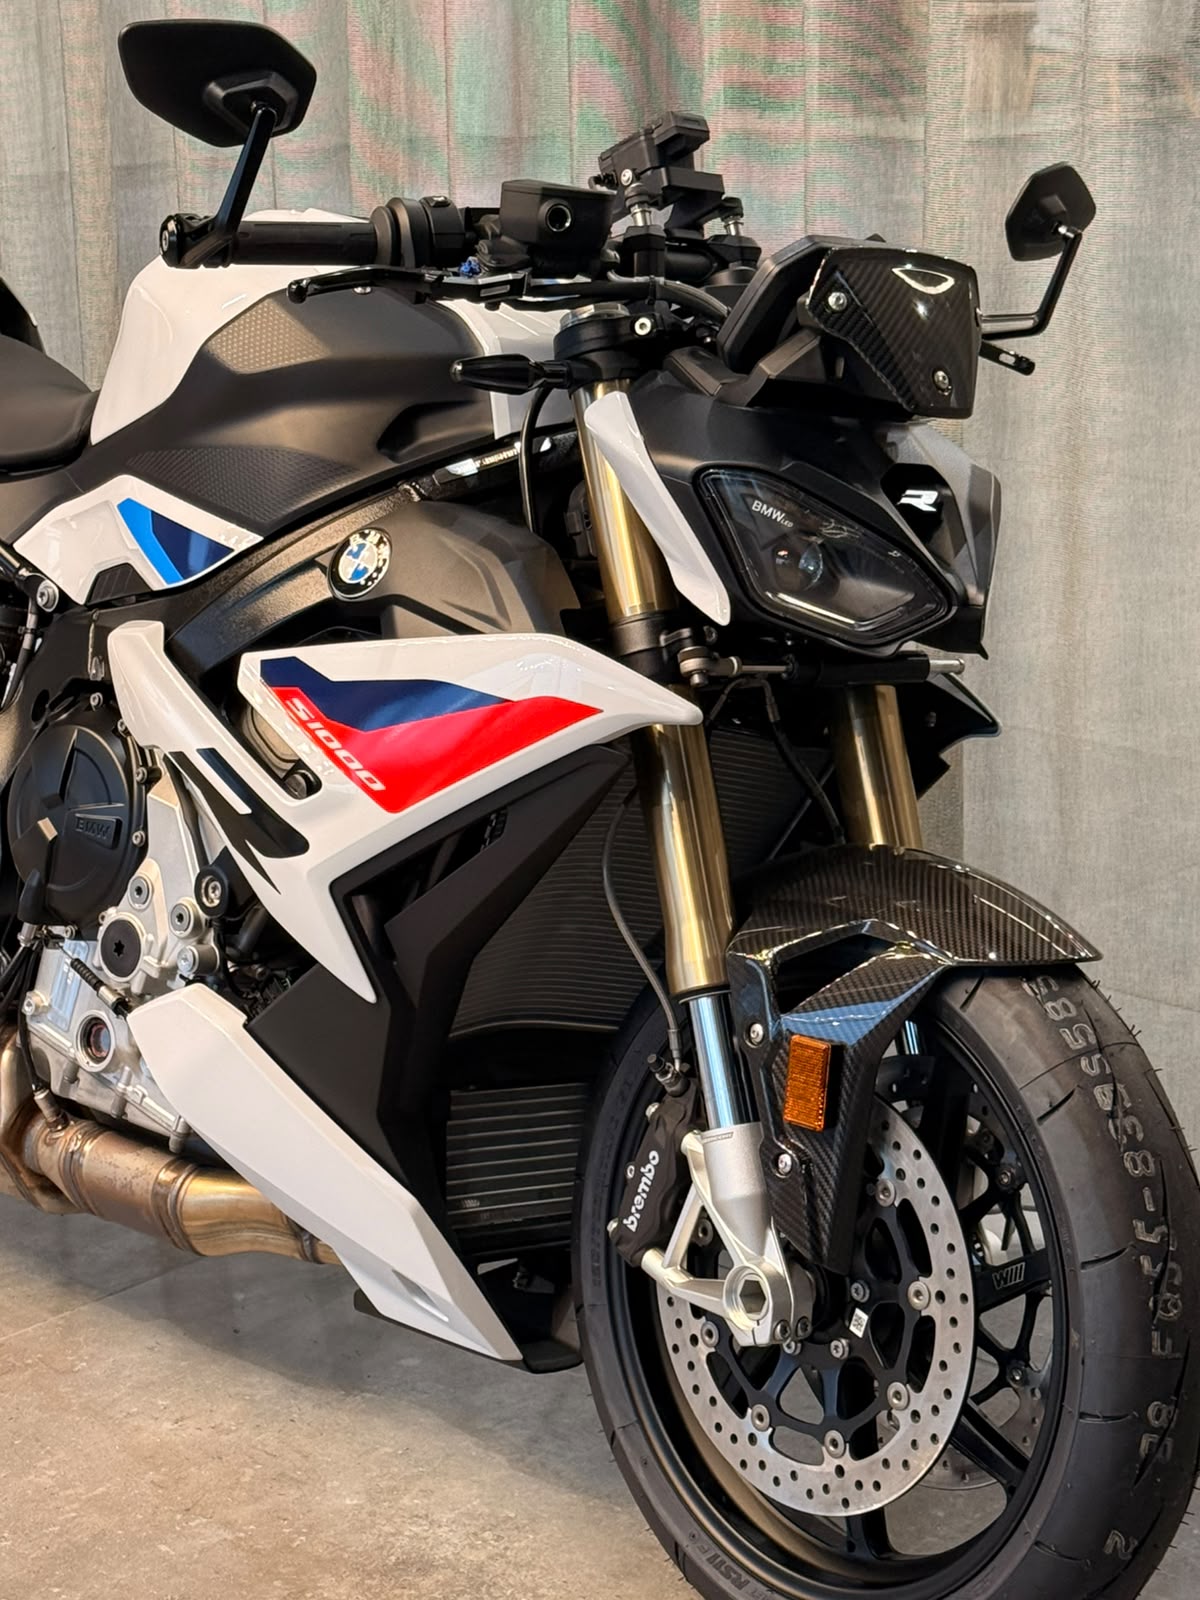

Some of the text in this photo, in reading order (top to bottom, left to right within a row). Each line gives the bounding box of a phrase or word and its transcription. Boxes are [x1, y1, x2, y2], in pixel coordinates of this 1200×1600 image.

[751, 499, 795, 528] BMW LED
[285, 697, 387, 792] S1000
[77, 818, 112, 840] BMW
[622, 1150, 660, 1233] brembo
